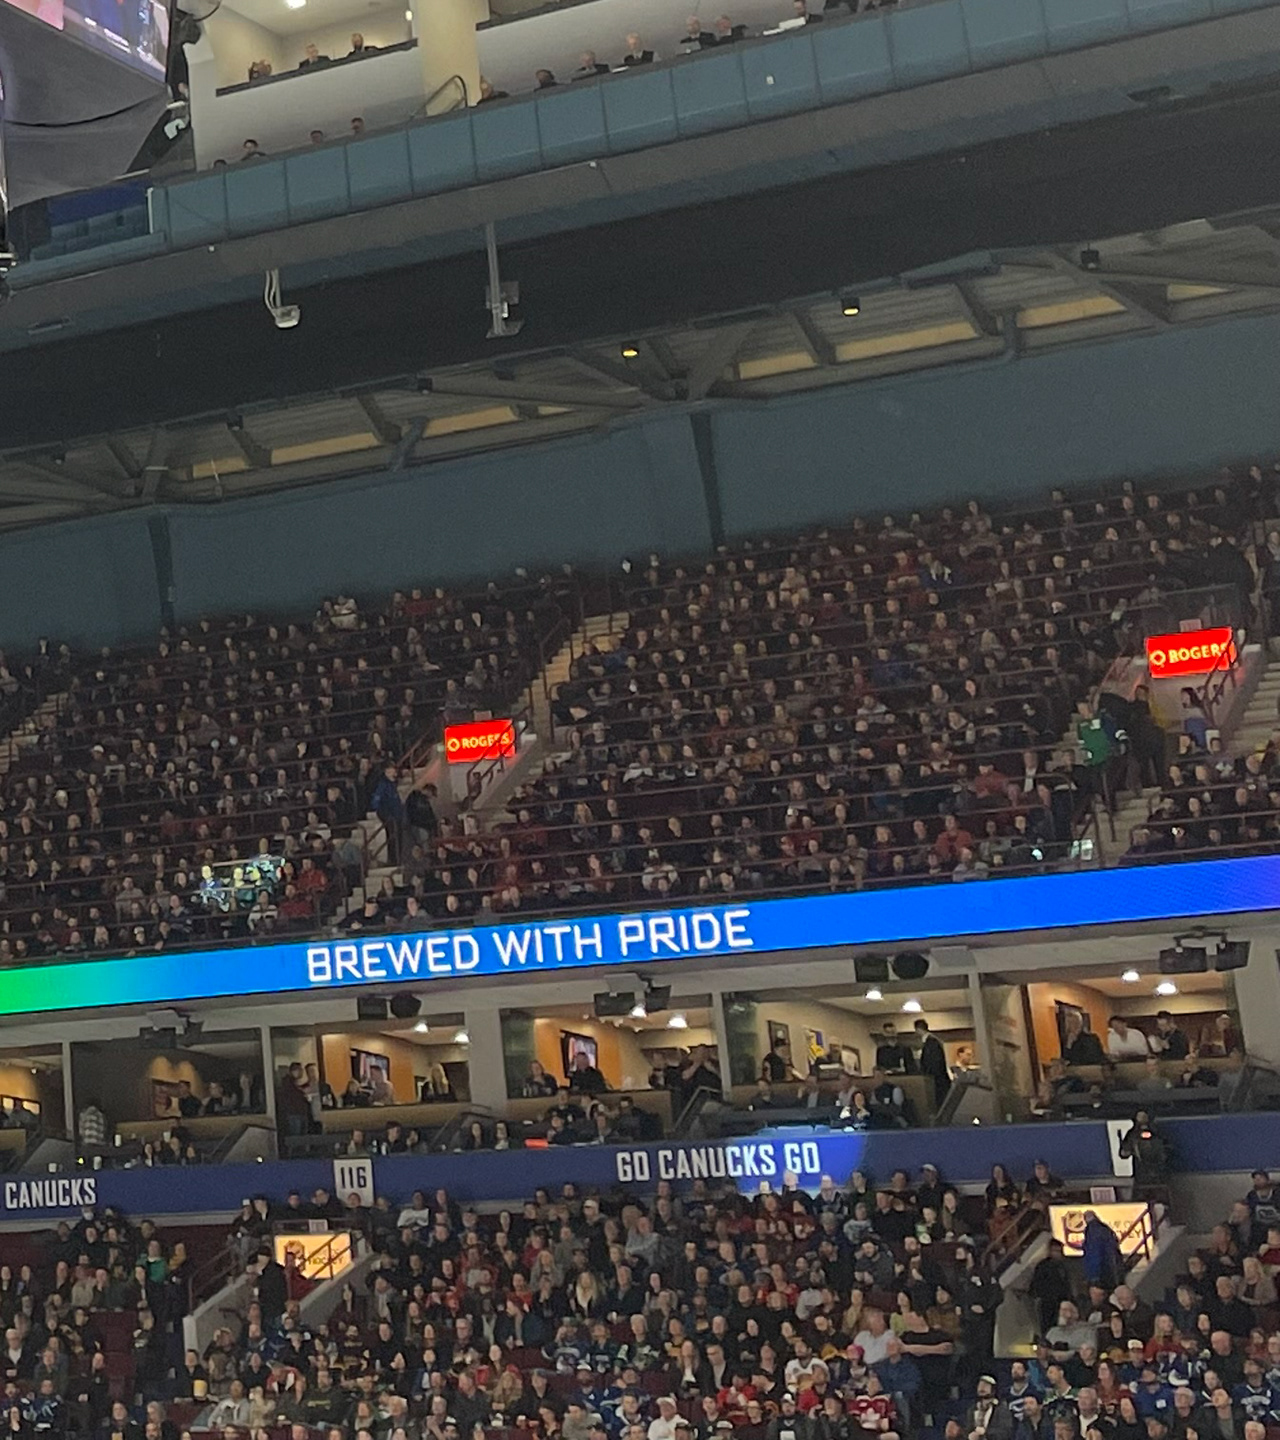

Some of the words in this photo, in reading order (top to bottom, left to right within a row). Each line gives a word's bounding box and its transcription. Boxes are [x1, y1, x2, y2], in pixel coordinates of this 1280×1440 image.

[307, 935, 480, 983] BREWED
[495, 921, 603, 966] WITH
[619, 909, 755, 958] PRIDE
[341, 1166, 367, 1189] 116
[616, 1150, 651, 1182] GO
[657, 1143, 778, 1180] CANUCKS
[784, 1141, 821, 1175] GO
[5, 1176, 97, 1209] CANUCKS
